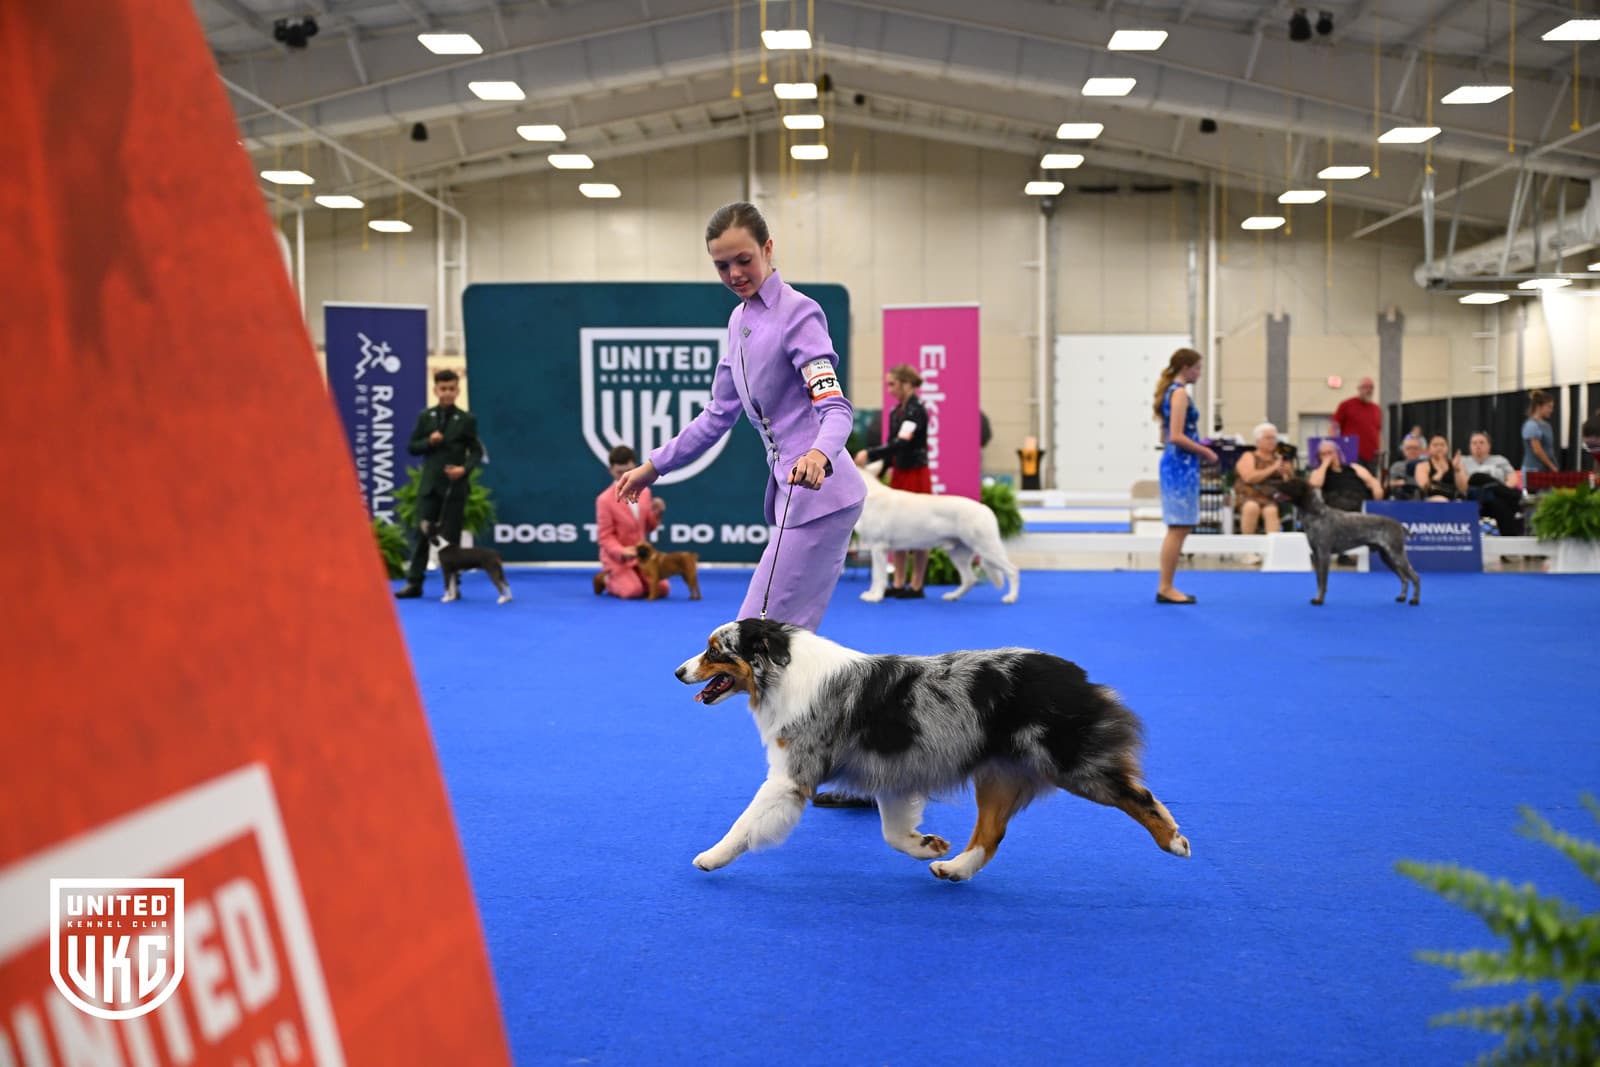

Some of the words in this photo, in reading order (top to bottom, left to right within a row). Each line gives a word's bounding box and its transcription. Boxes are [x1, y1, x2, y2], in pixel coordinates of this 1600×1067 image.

[600, 346, 712, 370] UNITED
[355, 384, 368, 416] PET
[919, 344, 946, 496] Eukan
[355, 424, 368, 513] INSURA
[371, 384, 395, 526] RAINWALK
[494, 523, 578, 543] DOGS
[670, 524, 715, 543] DO
[721, 524, 780, 544] MO
